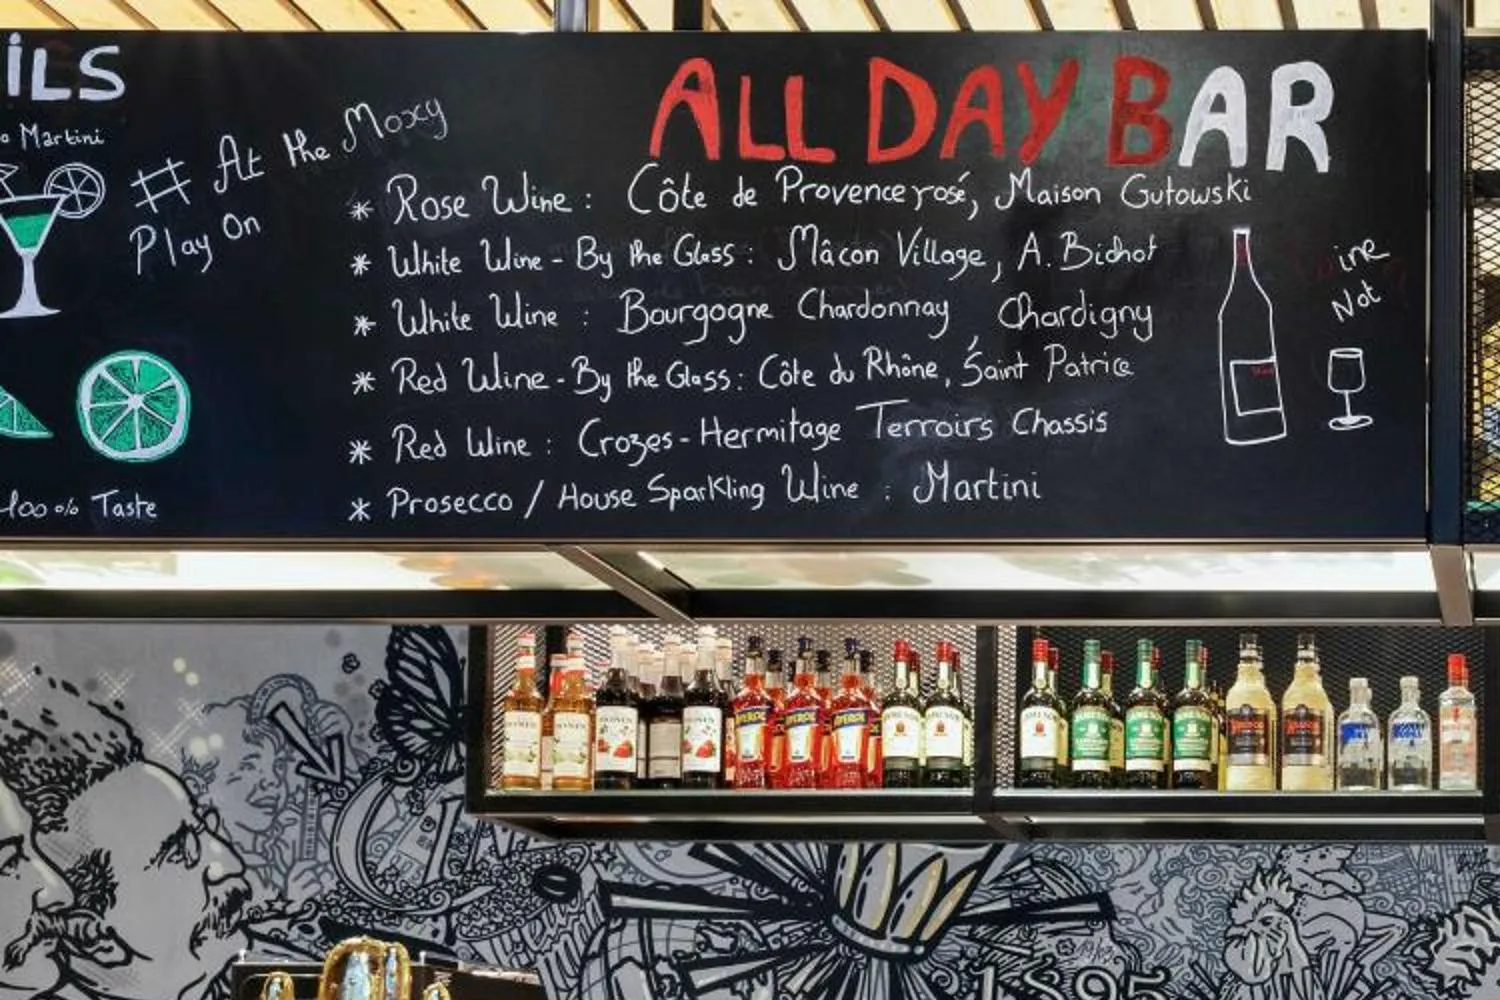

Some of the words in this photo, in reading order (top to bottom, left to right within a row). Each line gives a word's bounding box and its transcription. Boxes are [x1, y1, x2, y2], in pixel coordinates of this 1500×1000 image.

[20, 123, 104, 149] Martini
[649, 57, 836, 163] ALL
[868, 57, 1079, 167] DAY
[1105, 57, 1335, 173] BAR
[214, 135, 264, 193] At
[283, 129, 330, 167] the
[343, 97, 448, 152] Moxy
[386, 174, 470, 224] Rose
[628, 162, 707, 214] Côte
[733, 176, 757, 208] de
[775, 165, 906, 205] Provence
[994, 166, 1101, 212] Maison
[130, 224, 212, 275] Play
[223, 213, 260, 240] On
[387, 240, 462, 278] White
[480, 236, 543, 272] Wine
[576, 236, 613, 279] By
[629, 239, 662, 267] the
[778, 224, 879, 271] Mâcon
[392, 298, 472, 337] White
[617, 288, 773, 346] Bourgogne
[998, 289, 1152, 342] Chardigny
[1332, 280, 1381, 322] Not
[391, 357, 447, 394] Red
[462, 352, 550, 392] Wine
[571, 356, 611, 403] By
[627, 357, 659, 388] the
[759, 354, 816, 389] Côte
[830, 352, 854, 384] du
[392, 424, 446, 463] Red
[856, 399, 993, 441] Terroirs
[1011, 407, 1108, 437] Chassis
[91, 490, 157, 518] Taste
[386, 487, 512, 518] Prosecco
[558, 483, 637, 510] House
[913, 460, 1041, 504] Martini
